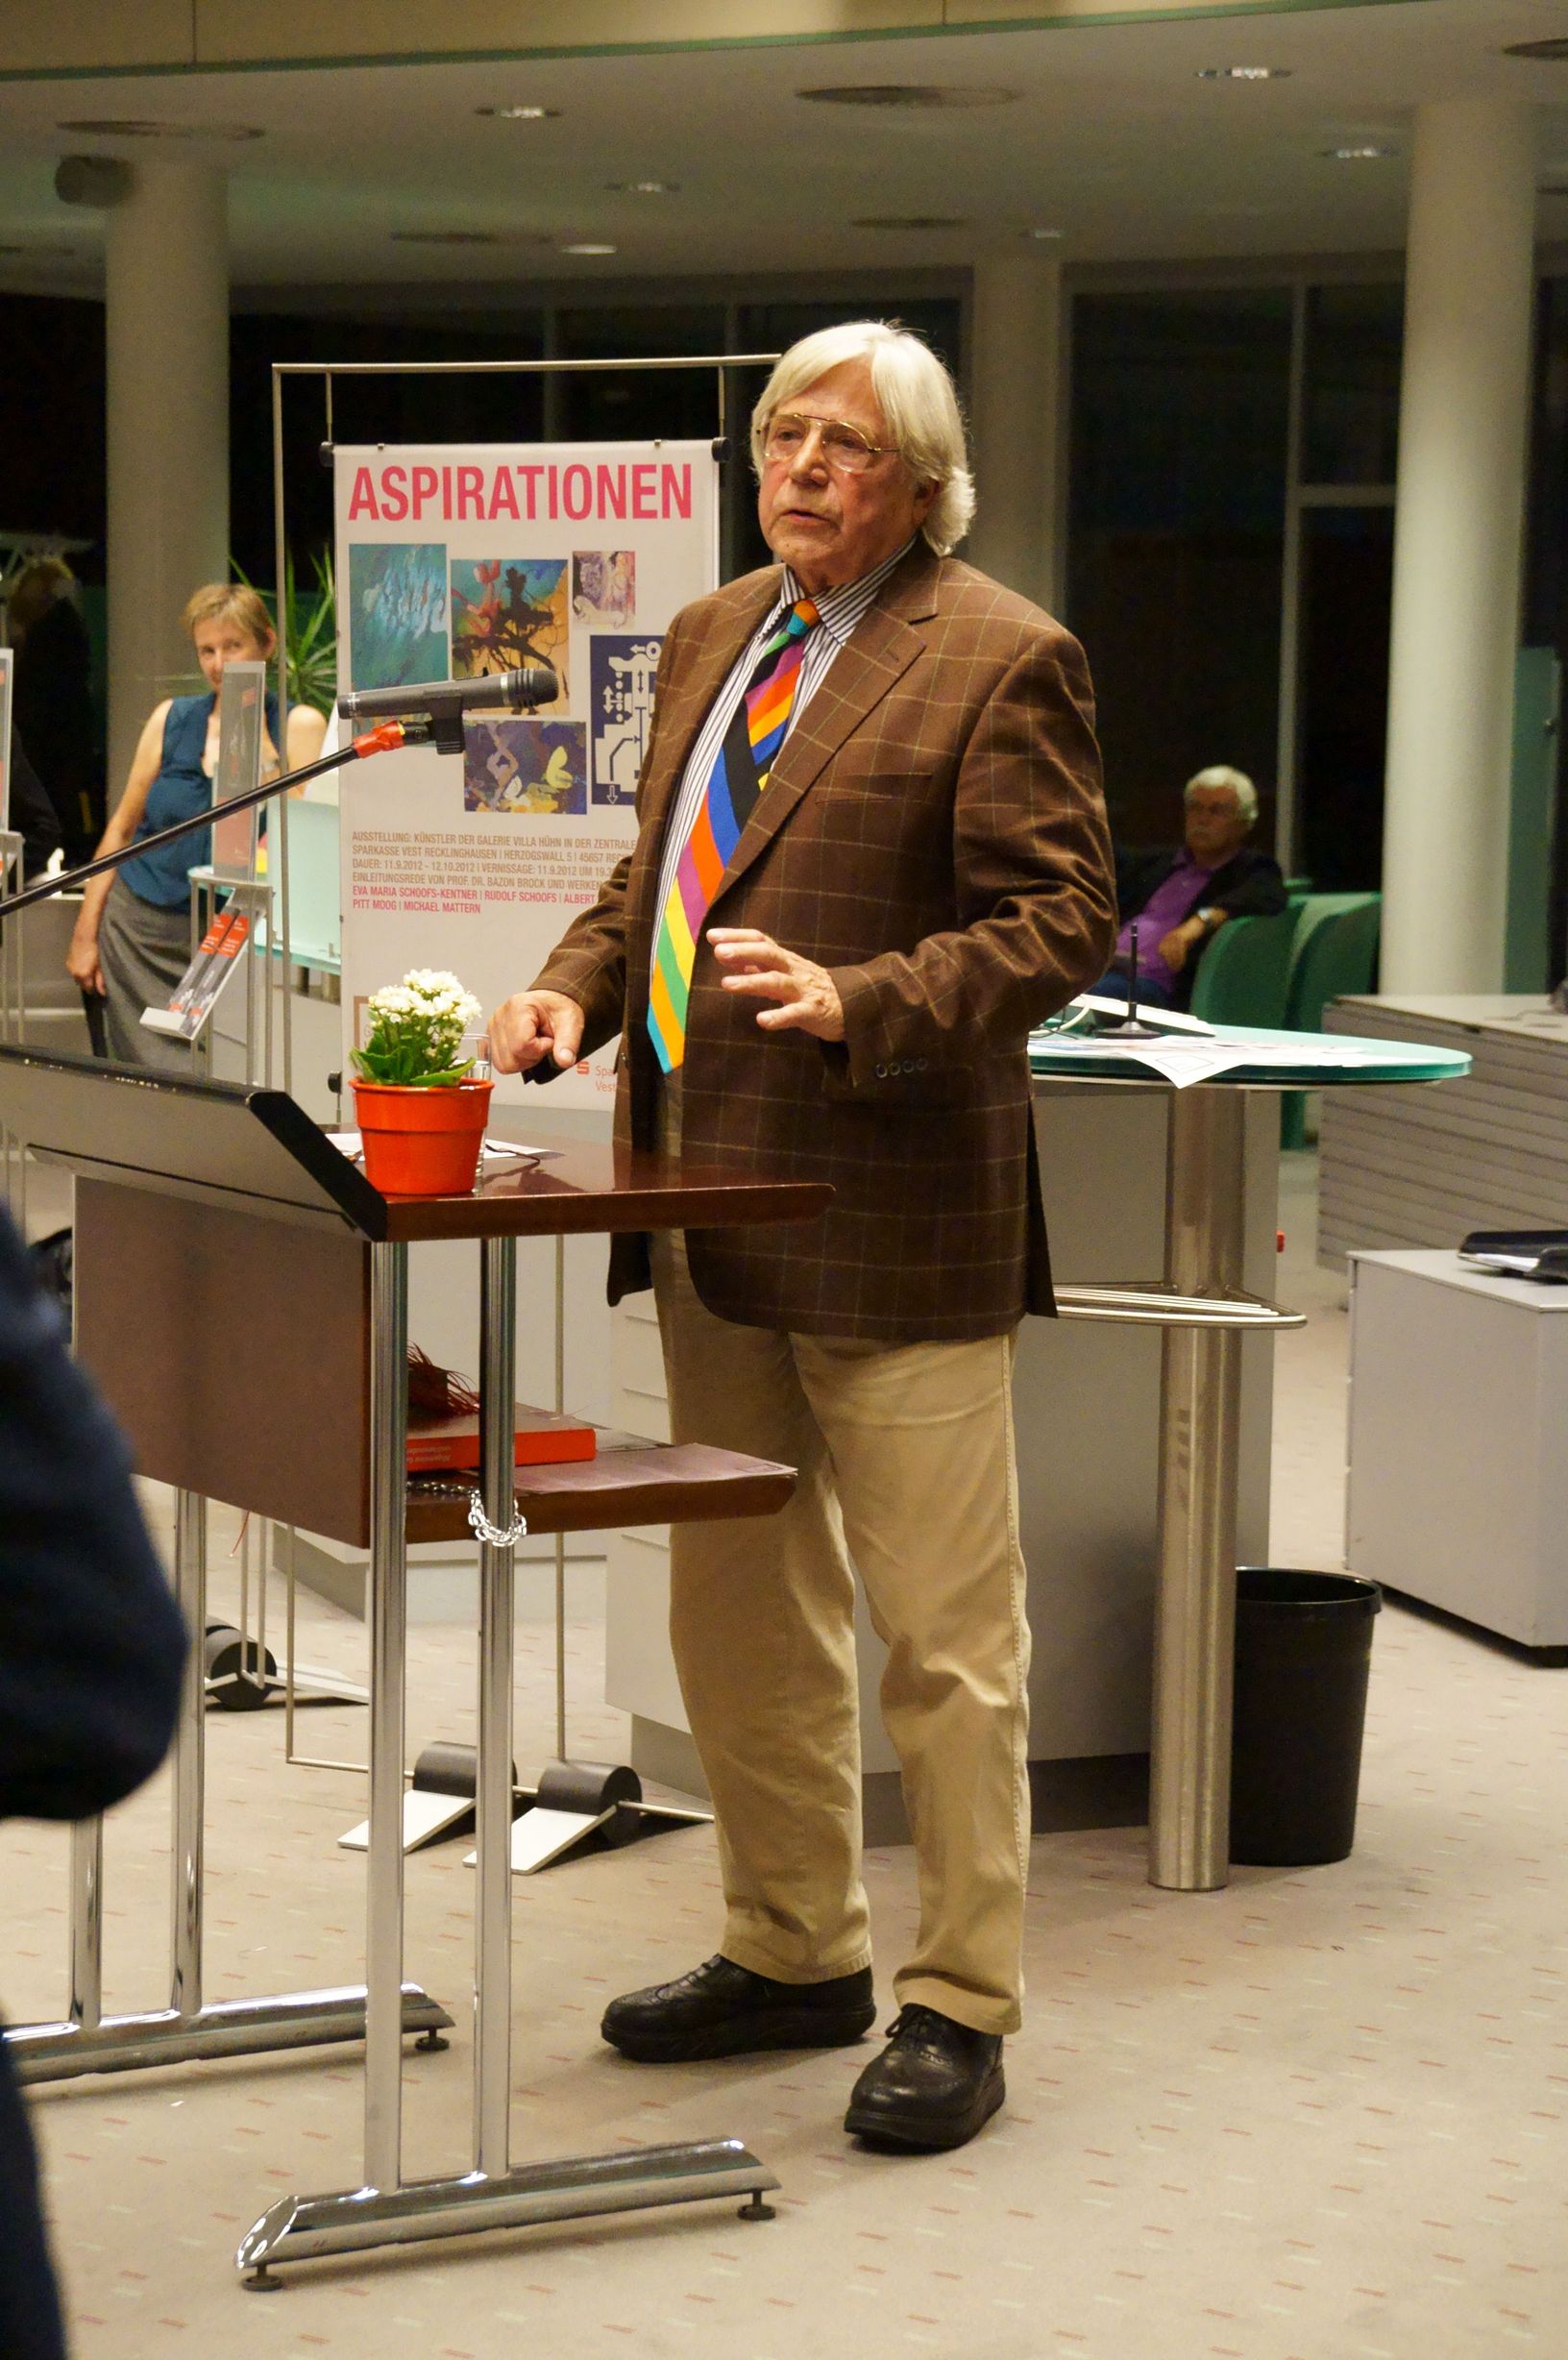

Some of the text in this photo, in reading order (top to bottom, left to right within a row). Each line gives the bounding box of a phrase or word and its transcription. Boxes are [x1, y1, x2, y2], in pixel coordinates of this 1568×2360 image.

[348, 464, 692, 521] ASPIRATIONEN
[414, 831, 456, 845] KÜNSTLER
[458, 834, 475, 846] DER
[477, 834, 510, 846] GALERIE
[513, 835, 536, 847] VILLA
[539, 835, 561, 848] HÜHN
[564, 838, 573, 848] IN
[575, 838, 591, 848] DER
[353, 845, 400, 856] SPARKASSE
[402, 847, 422, 857] VEST
[425, 847, 497, 859] RECKLINGHAUSEN
[503, 849, 564, 861] HERZOGSWALL
[578, 852, 603, 863] 45657
[384, 860, 423, 870] 11.9.2012
[432, 861, 475, 873] 12.10.2012
[538, 865, 576, 875] 11.9.2012
[579, 866, 592, 876] UM
[353, 872, 425, 883] EINLEITUNGSREDE
[428, 873, 444, 884] VON
[487, 876, 514, 887] BAZON
[517, 878, 545, 889] BROCK
[548, 879, 565, 889] UND
[353, 885, 368, 896] EVA
[370, 886, 397, 897] MARIA
[399, 887, 478, 900] SCHOOFS-KENTNER
[484, 890, 517, 901] RUDOLF
[519, 891, 557, 902] SCHOOFS
[564, 893, 596, 904] ALBERT
[353, 898, 370, 909] PITT
[373, 899, 397, 910] MOOG
[404, 900, 439, 912] MICHAEL
[442, 901, 480, 914] MATTERN
[596, 1065, 615, 1079] Spa
